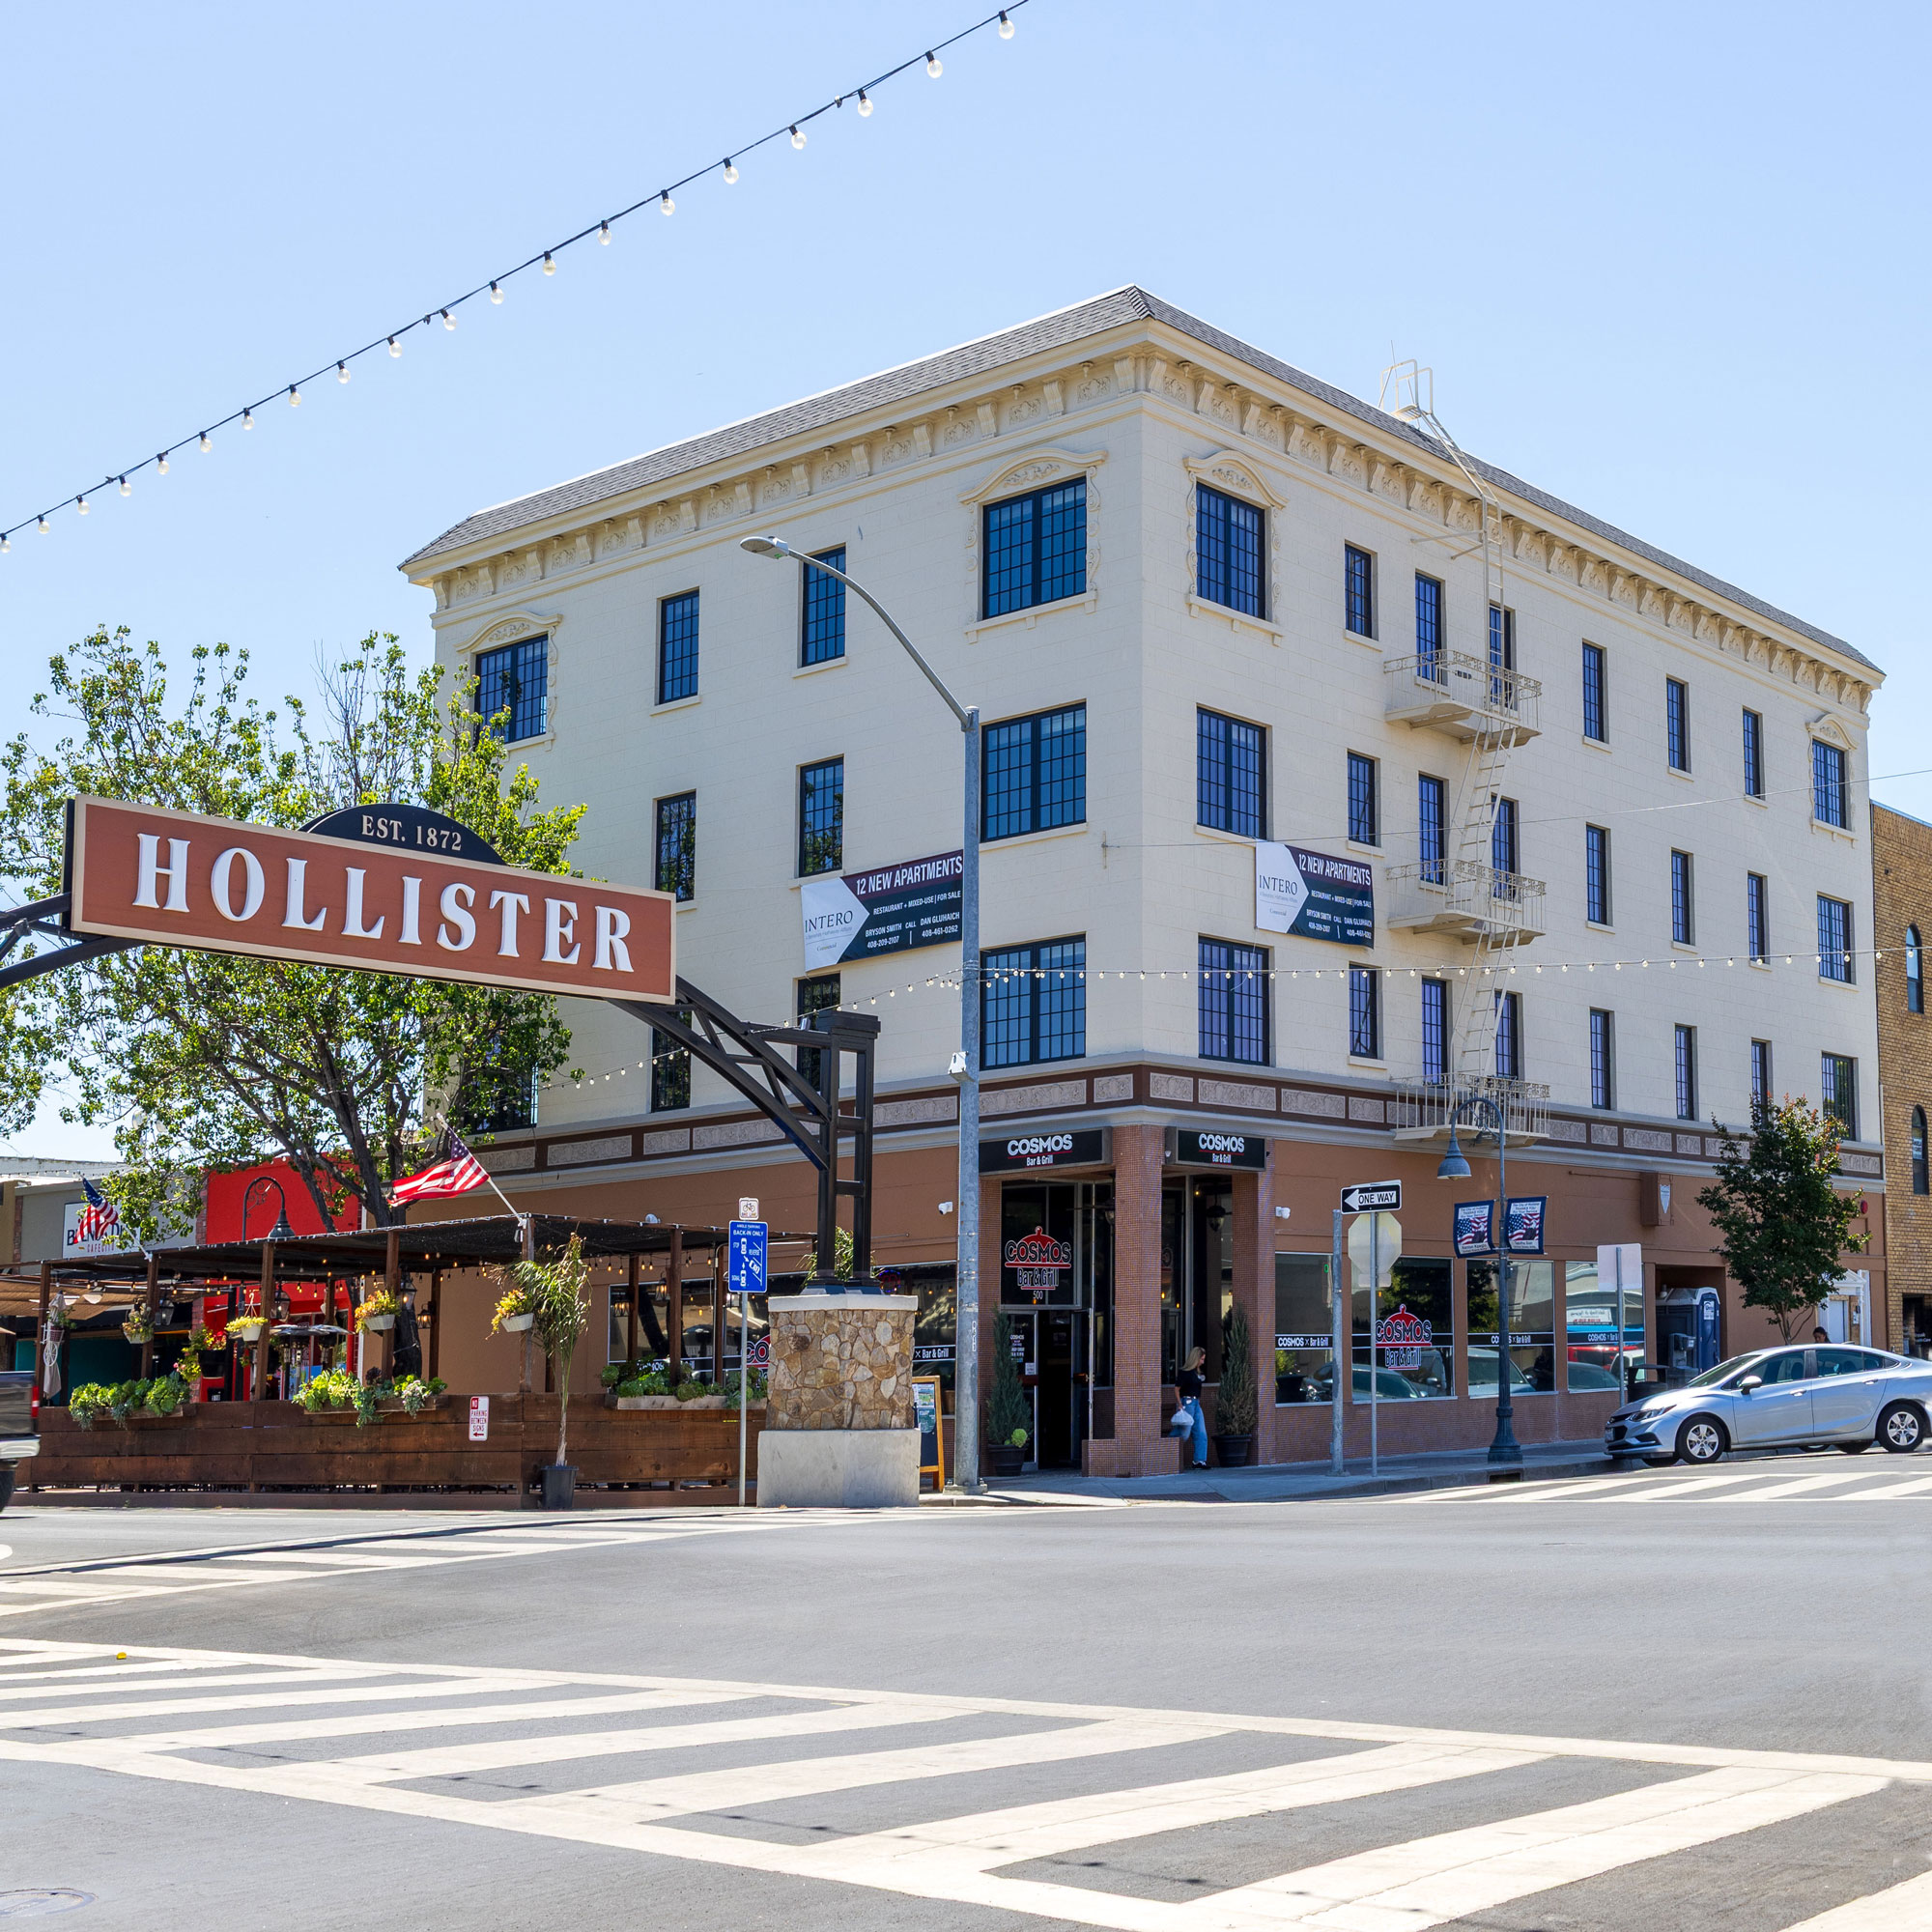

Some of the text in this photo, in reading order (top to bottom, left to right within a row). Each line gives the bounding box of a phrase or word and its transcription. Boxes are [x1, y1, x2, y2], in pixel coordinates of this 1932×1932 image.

[361, 814, 462, 851] EST. 1872
[856, 856, 963, 895] 12 NEW APARTMENTS
[1298, 854, 1372, 886] 12 NEW APARTMENTS
[1259, 874, 1298, 895] INTERO
[131, 833, 635, 973] HOLLISTER
[873, 902, 904, 915] RESTAURANT
[908, 895, 934, 908] MIXED-USE
[937, 894, 947, 902] FOR
[948, 891, 961, 900] SALE
[805, 910, 854, 933] INTERO
[866, 926, 886, 937] BRYSON
[887, 923, 902, 933] SMITH
[921, 917, 931, 925] DAN
[1007, 1134, 1073, 1156] COSMOS
[1198, 1133, 1245, 1152] COSMOS
[1026, 1154, 1054, 1167] Bar & Grill
[1358, 1192, 1395, 1205] ONE WAY
[1005, 1239, 1071, 1264] COSMOS
[1017, 1267, 1059, 1287] Bar & Grill
[1033, 1291, 1043, 1299] 500
[1376, 1320, 1433, 1342] COSMOS
[1587, 1333, 1606, 1342] COSMOS
[1277, 1337, 1304, 1347] COSMOS
[1320, 1336, 1328, 1347] Grill
[922, 1348, 949, 1358] Bar & Grill
[1384, 1348, 1399, 1366] Bar
[1406, 1347, 1421, 1367] Grill
